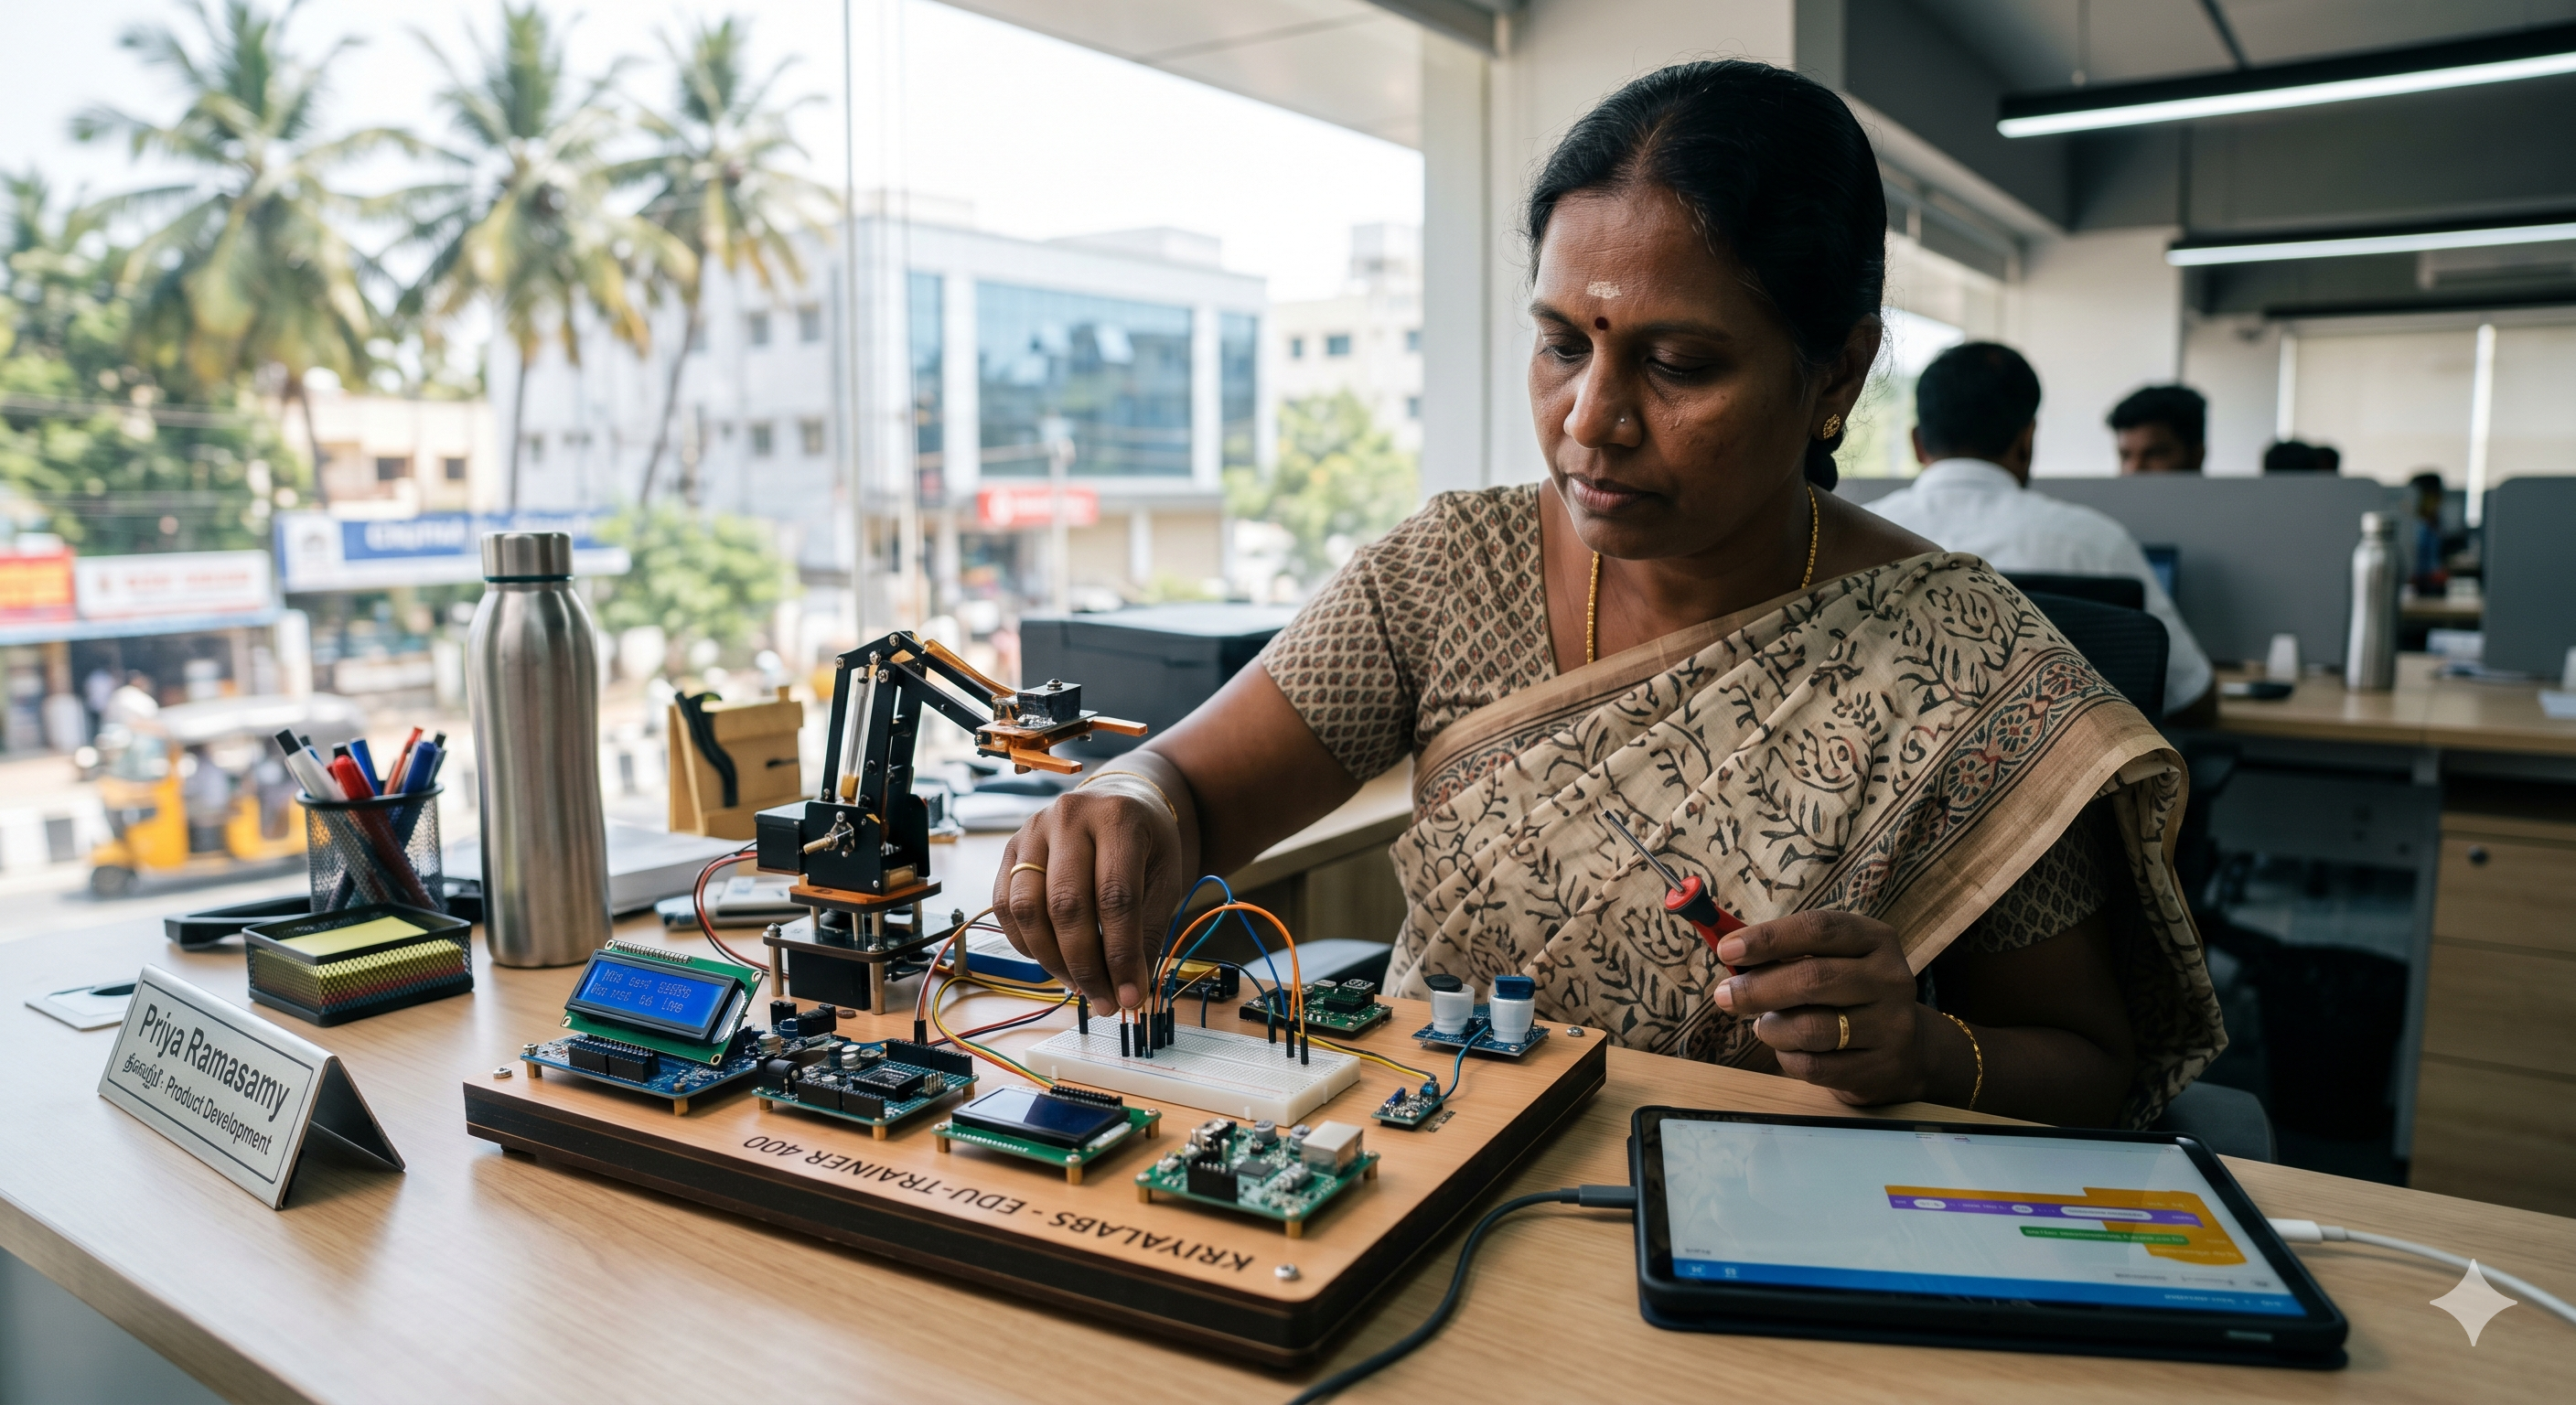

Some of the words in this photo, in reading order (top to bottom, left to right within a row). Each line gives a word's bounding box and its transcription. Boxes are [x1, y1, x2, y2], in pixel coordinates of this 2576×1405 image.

[138, 1003, 185, 1058] Priya
[183, 1026, 291, 1122] Ramasamy
[165, 1075, 205, 1115] Product
[203, 1098, 273, 1155] Development
[742, 1135, 803, 1156] 400
[804, 1150, 1027, 1216] EDU-TRAINER
[1047, 1210, 1254, 1271] KRIYALABS
